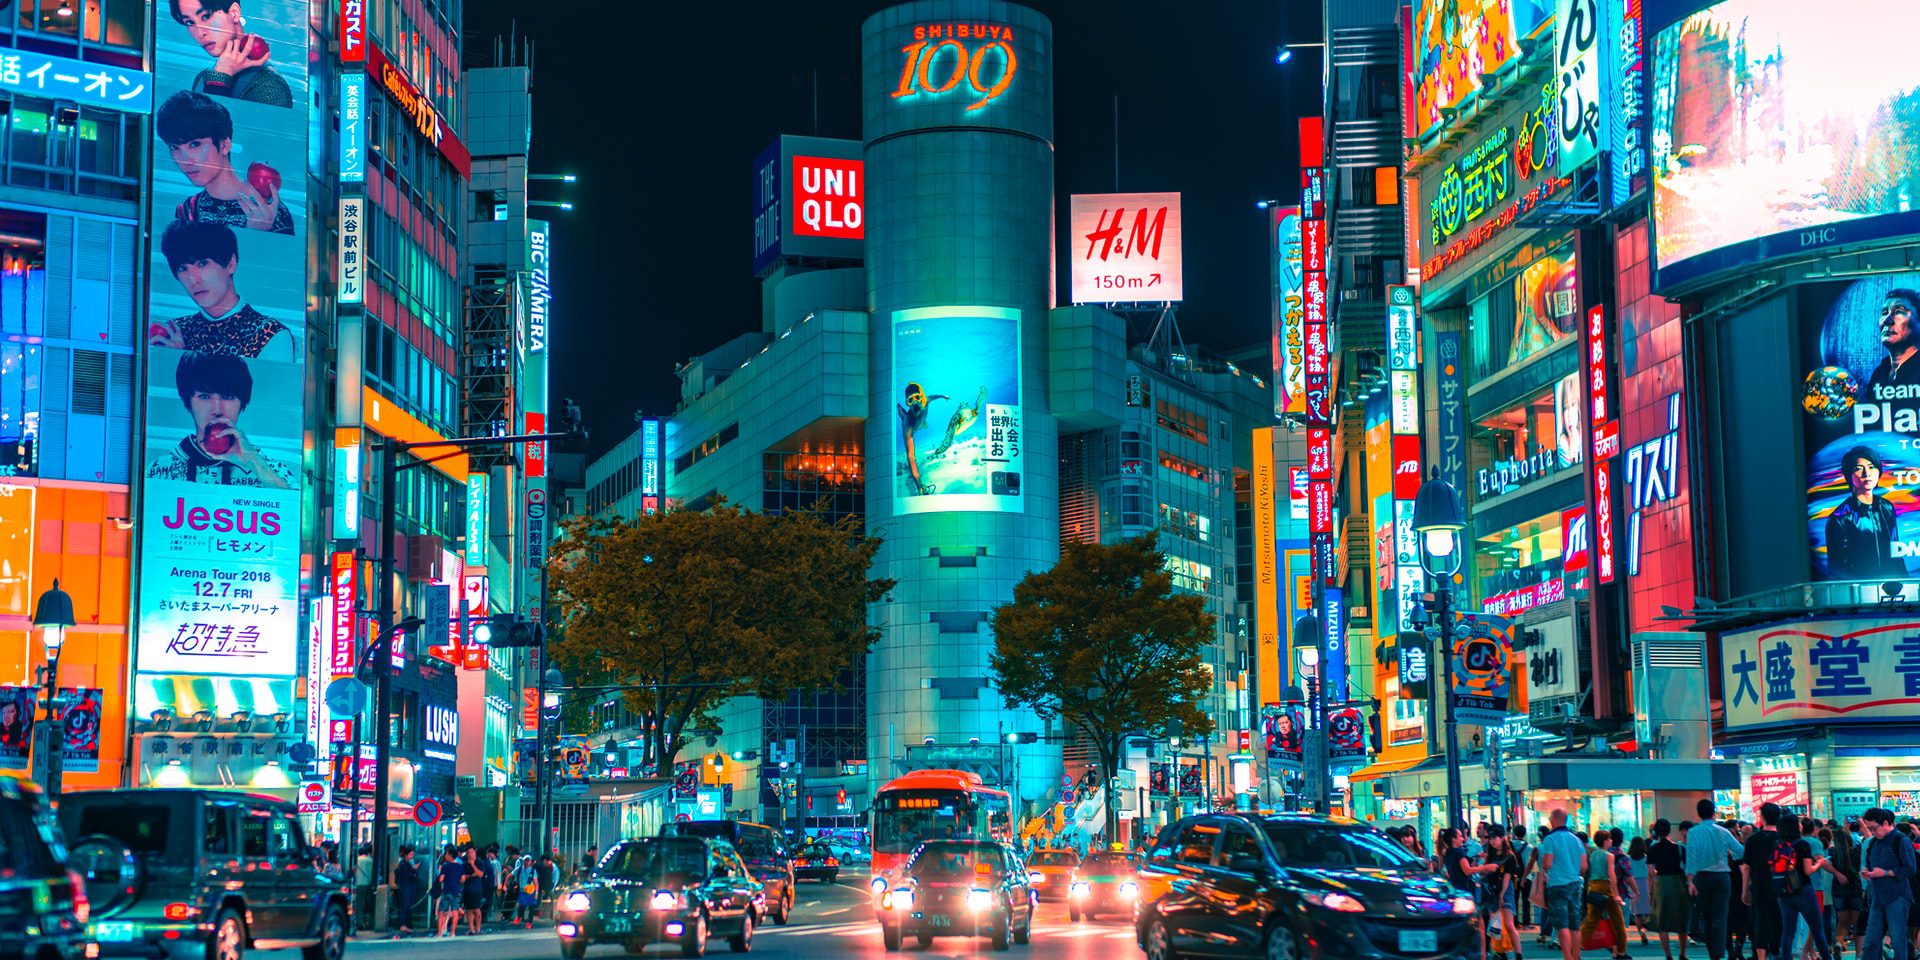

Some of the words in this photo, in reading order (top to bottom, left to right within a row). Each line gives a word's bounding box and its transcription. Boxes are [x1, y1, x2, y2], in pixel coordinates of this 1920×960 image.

[345, 0, 361, 50] ガスト
[914, 24, 1014, 41] SHIBUYA
[890, 38, 1018, 110] 109
[346, 85, 359, 171] 英会話イーオン
[416, 94, 443, 147] ガスト
[761, 160, 774, 209] THE
[802, 166, 856, 197] UNI
[1464, 148, 1508, 222] 西村
[755, 200, 779, 258] PRIME
[802, 199, 862, 231] QLO
[1085, 206, 1167, 262] H&M
[344, 204, 358, 294] 渋谷駅前ビル
[531, 231, 545, 263] BIC
[1800, 228, 1836, 247] DHC
[1094, 275, 1143, 288] 150m
[990, 415, 1019, 429] 世界に
[1853, 402, 1920, 434] Pla
[1441, 379, 1462, 498] サマーフルー
[1396, 460, 1418, 475] JTB
[1479, 448, 1554, 495] Euphoria
[163, 497, 281, 535] Jesus
[233, 499, 251, 507] NEW
[253, 500, 281, 508] SINGLE
[529, 520, 543, 569] 調剤薬局
[1262, 511, 1272, 585] Matsumoto
[170, 567, 207, 579] Arena
[212, 569, 238, 580] Tour
[241, 571, 271, 582] 2018
[193, 582, 231, 597] 12.7
[234, 589, 253, 598] FRI
[159, 600, 280, 616] さいたまスーパーアリーナ
[336, 585, 351, 665] サンドラッグ
[1328, 600, 1339, 651] MIZUHO
[166, 622, 268, 658] 超特急
[1480, 701, 1494, 709] Tok
[426, 705, 458, 746] LUSH
